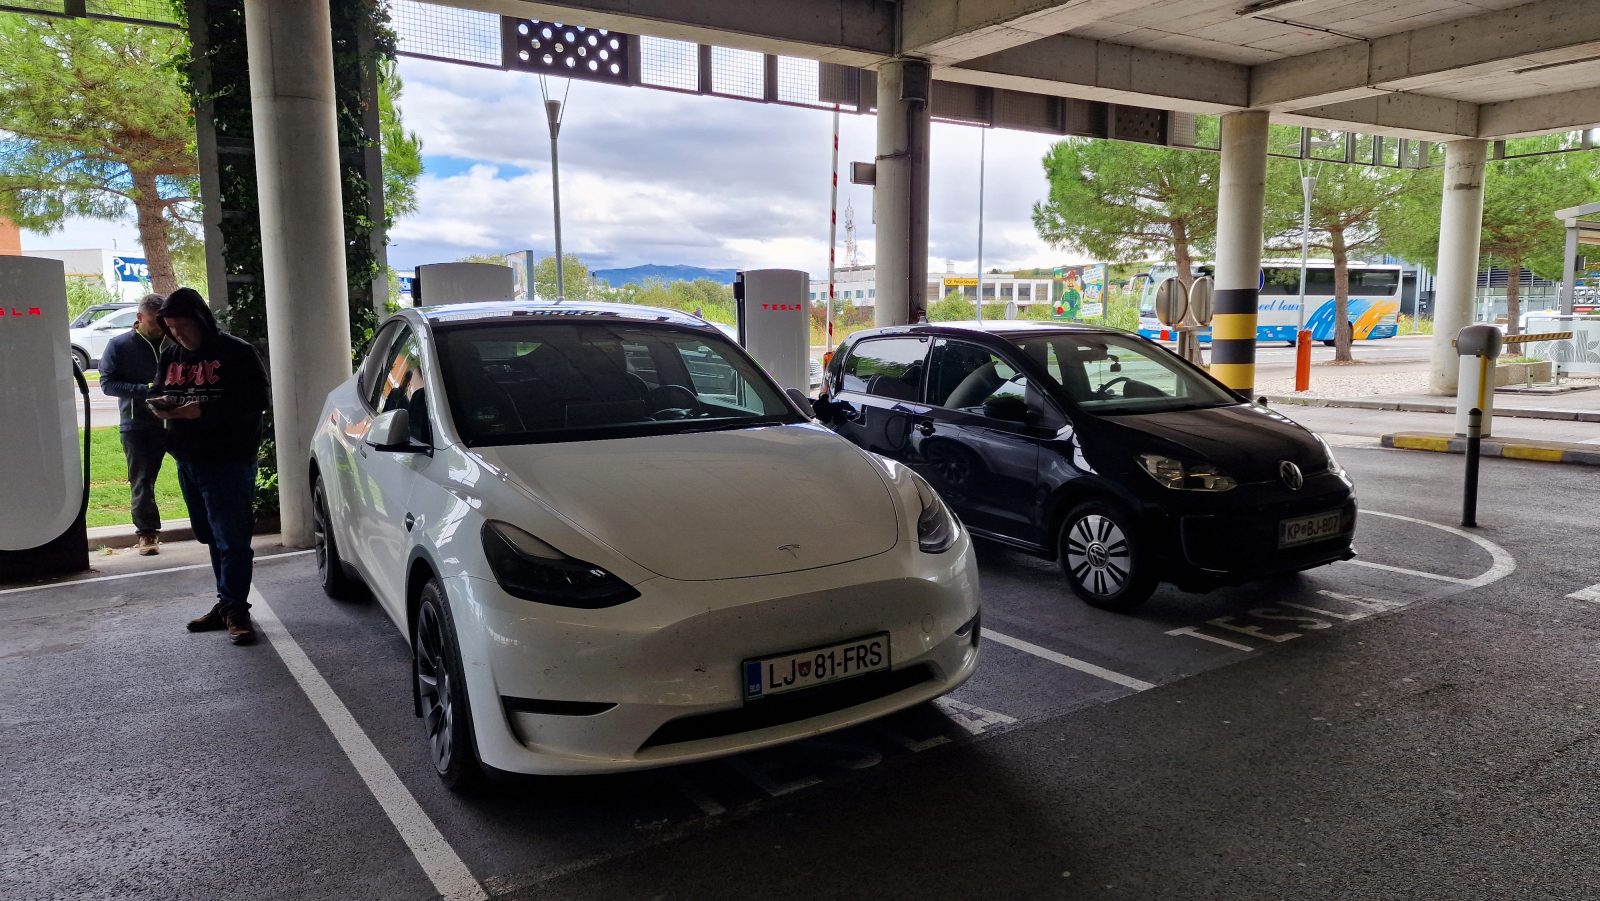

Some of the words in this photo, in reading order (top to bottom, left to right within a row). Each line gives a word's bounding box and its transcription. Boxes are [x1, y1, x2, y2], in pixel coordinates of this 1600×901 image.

[124, 262, 149, 277] JYS
[762, 303, 802, 312] TESLA
[1164, 589, 1412, 652] TESLA
[769, 659, 796, 689] LJ
[814, 641, 882, 679] 81-FRS
